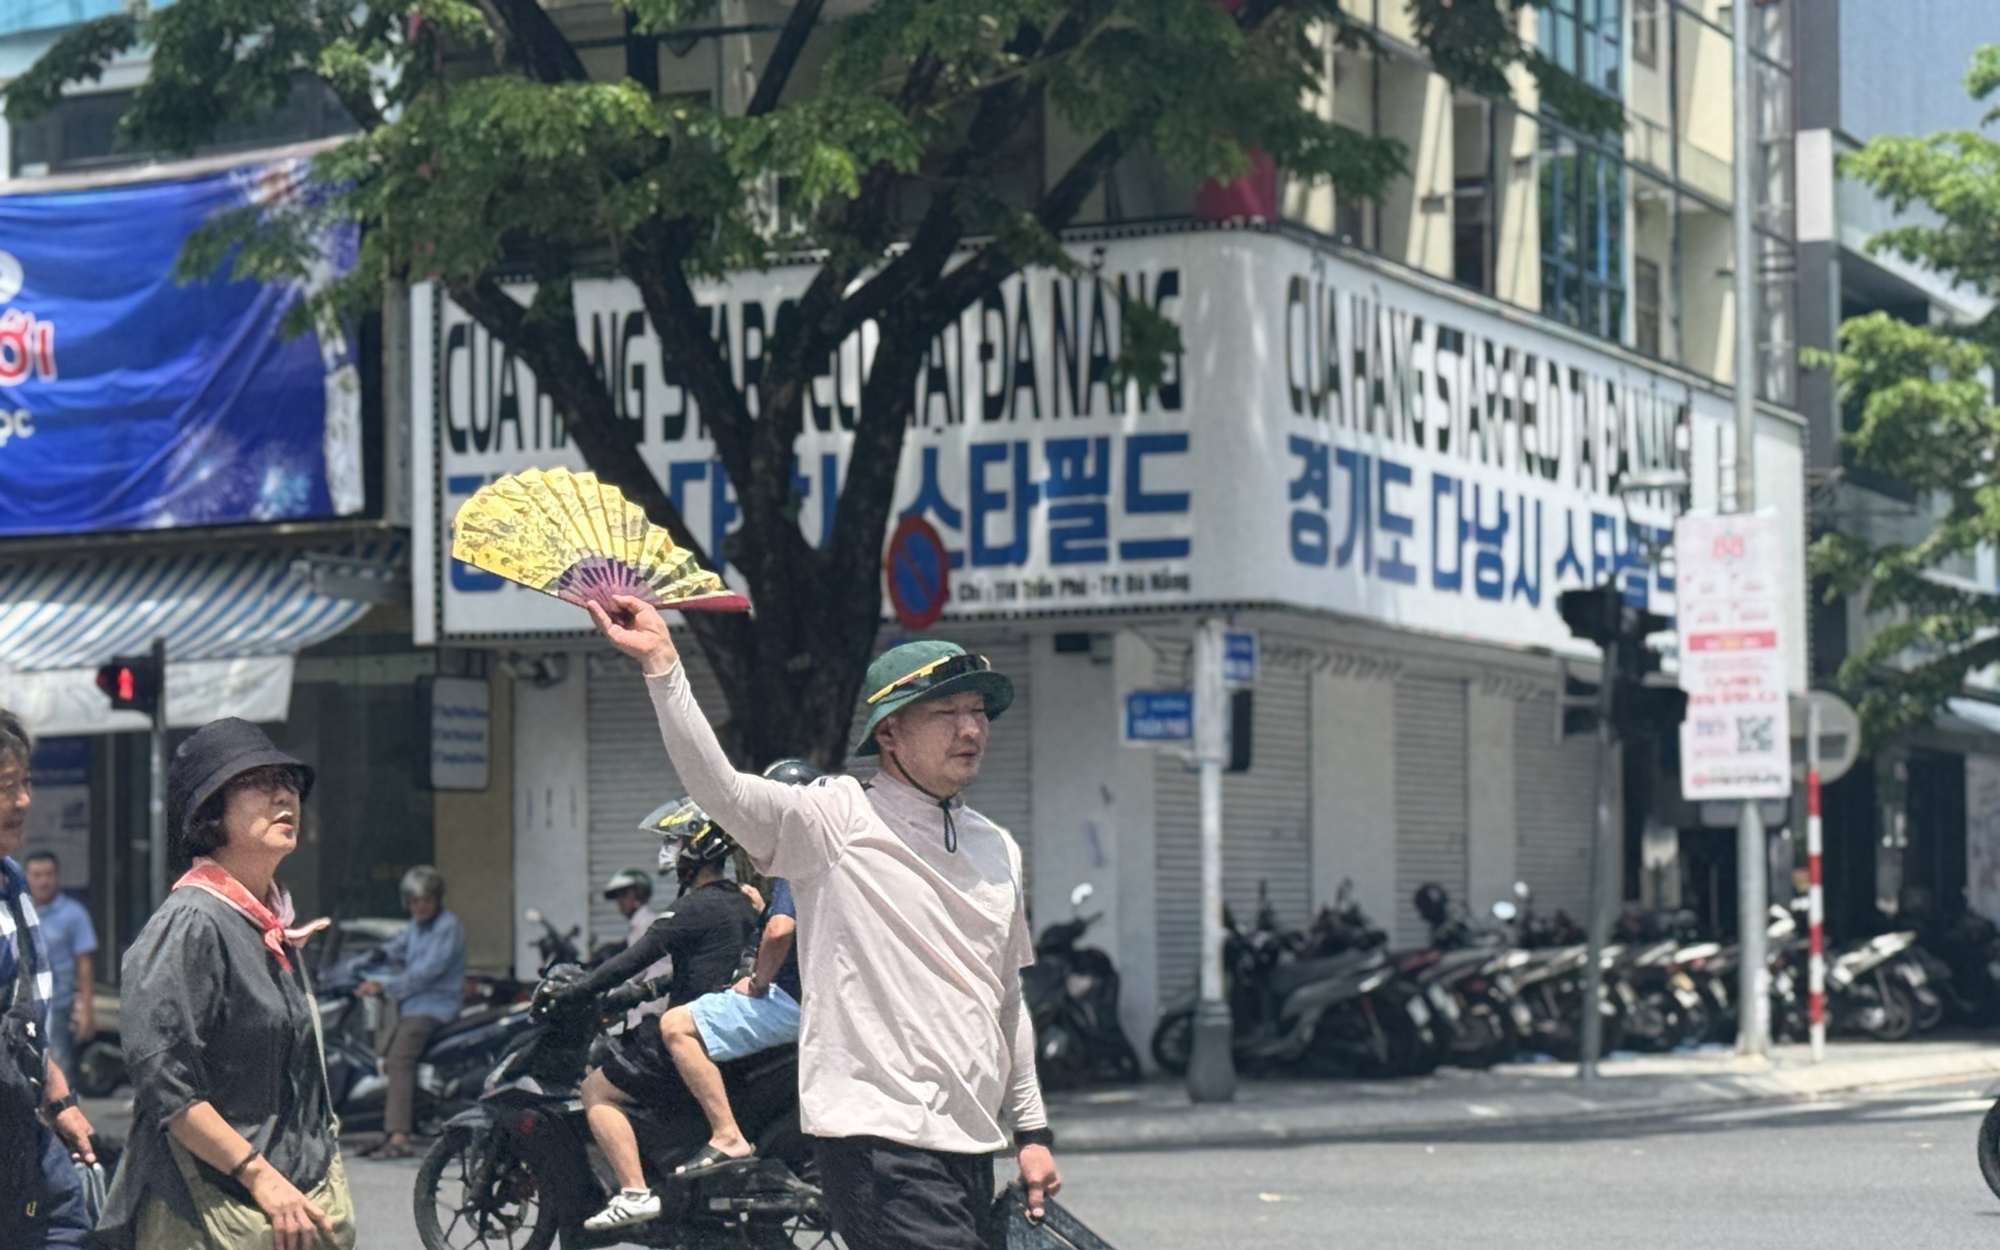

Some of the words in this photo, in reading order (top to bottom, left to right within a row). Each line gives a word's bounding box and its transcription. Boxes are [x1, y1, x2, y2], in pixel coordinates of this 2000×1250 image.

[895, 434, 1191, 569] 스타필드
[1288, 433, 1417, 586] 경기도
[1431, 471, 1542, 609] 다낭시
